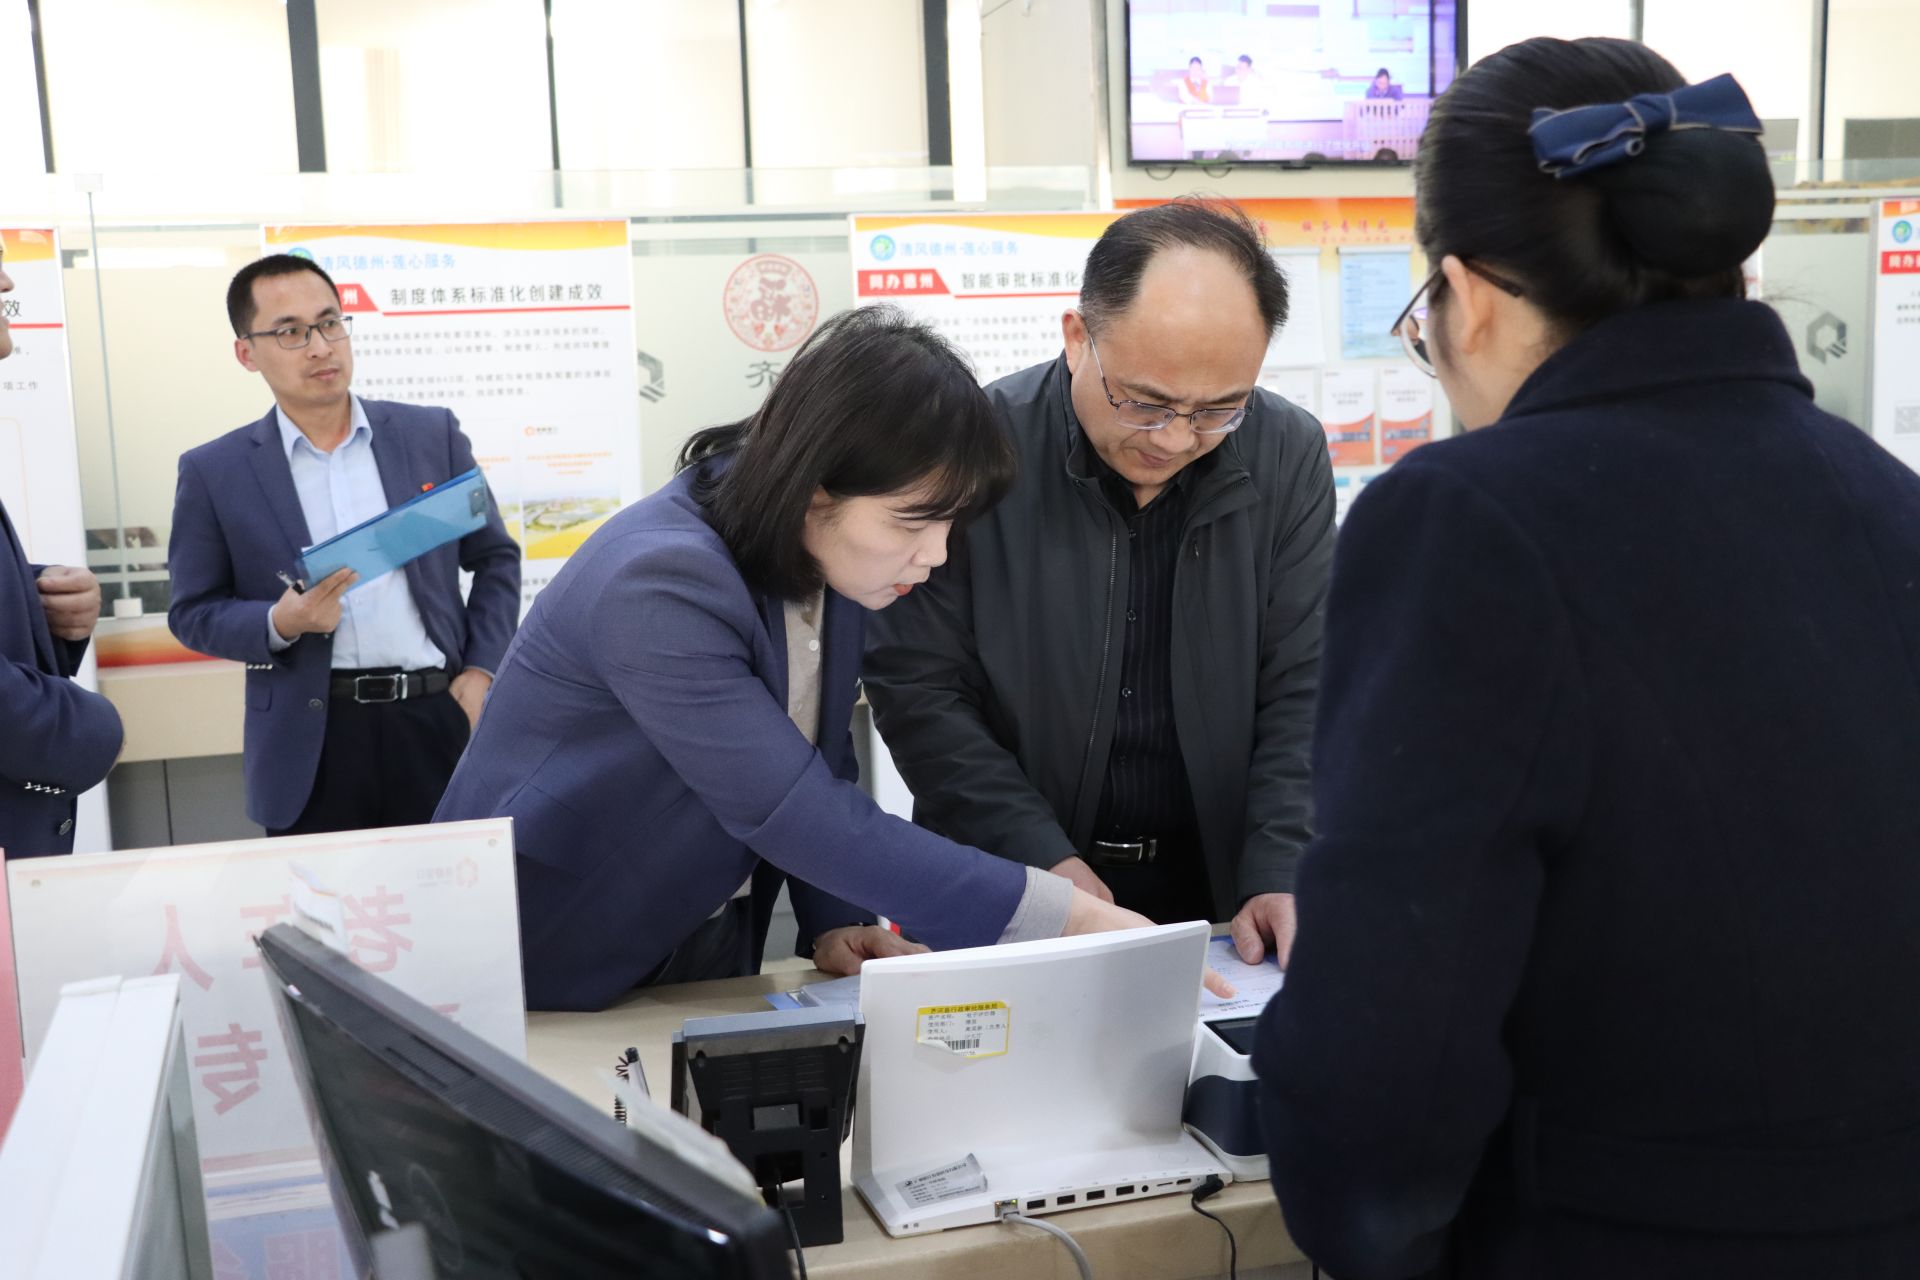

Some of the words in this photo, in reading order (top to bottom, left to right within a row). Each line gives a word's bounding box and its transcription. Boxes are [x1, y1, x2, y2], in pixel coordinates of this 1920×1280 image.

[961, 270, 1080, 289] 智能审批标准化
[342, 288, 358, 304] 州
[390, 283, 604, 306] 制度体系标准化创建成效
[4, 299, 22, 317] 效
[745, 360, 783, 389] 齐
